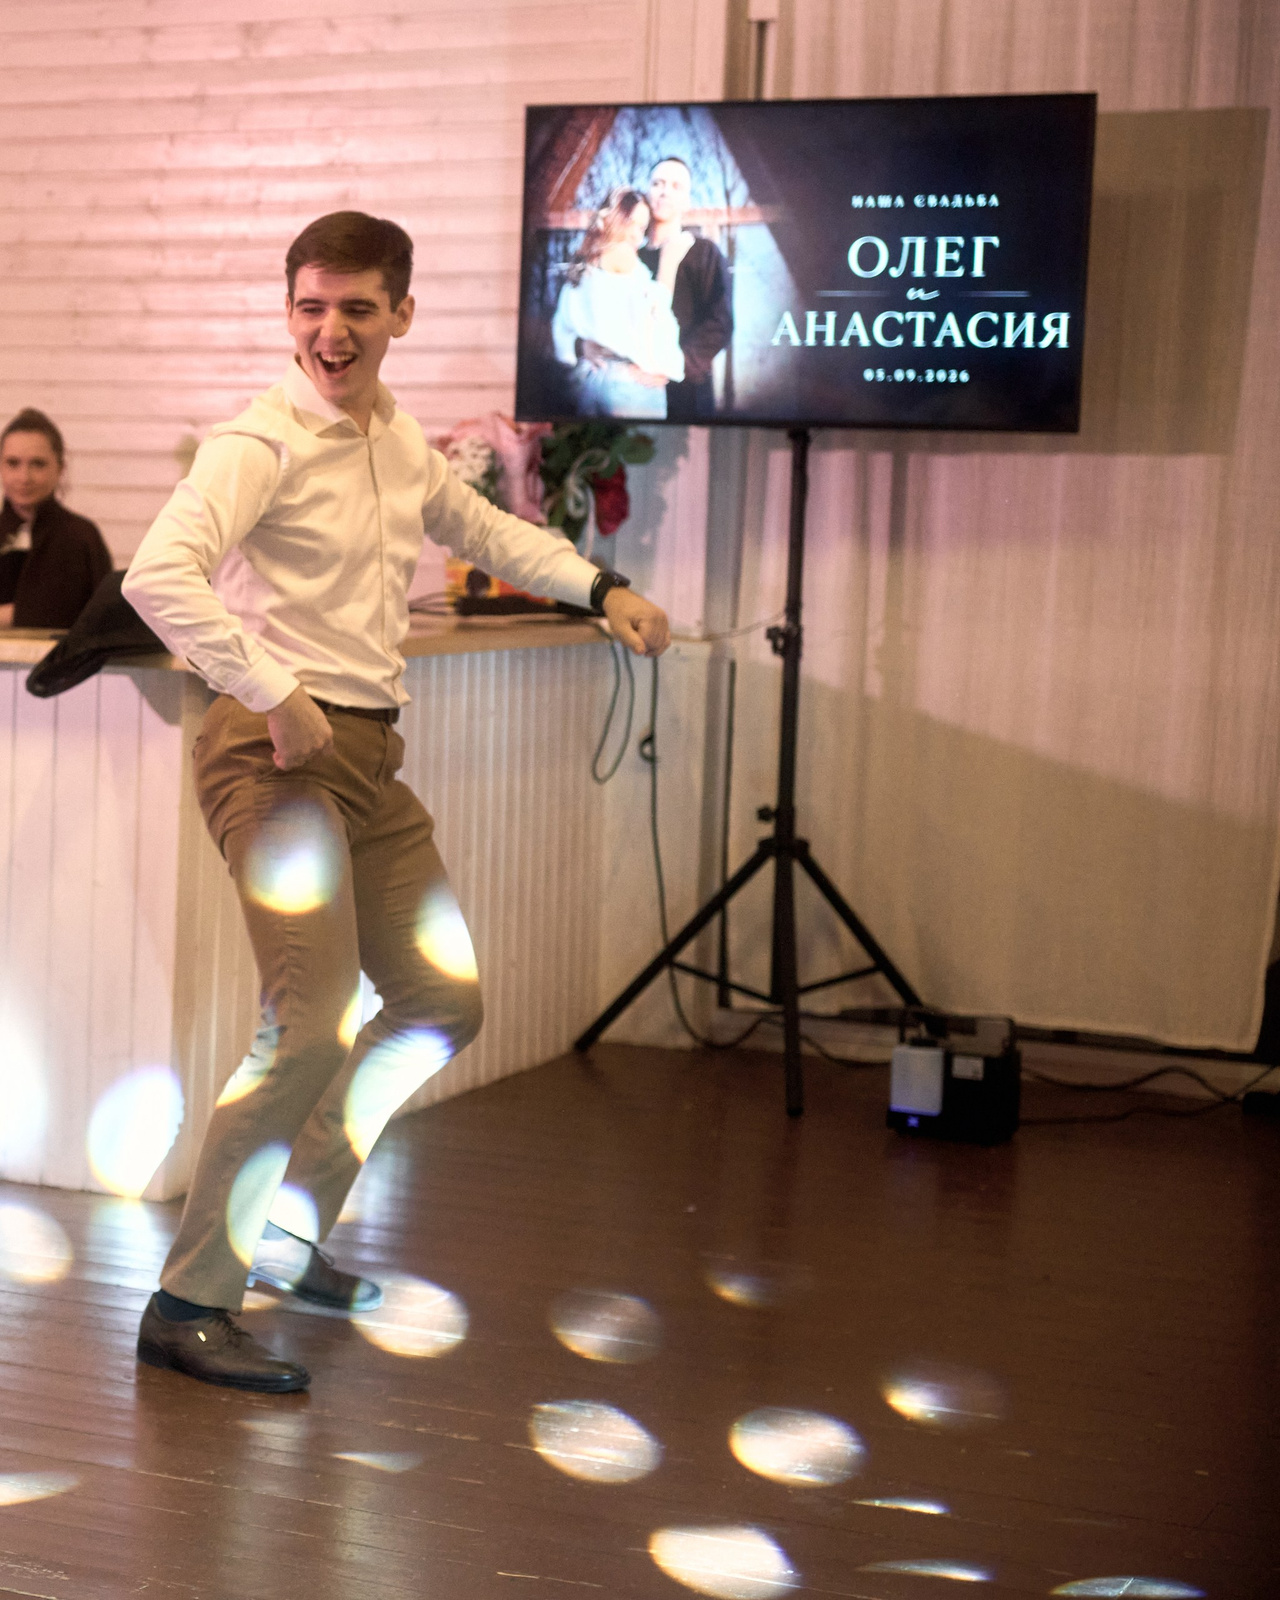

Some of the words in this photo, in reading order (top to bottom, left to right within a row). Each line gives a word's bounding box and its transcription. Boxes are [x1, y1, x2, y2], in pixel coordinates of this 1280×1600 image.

[851, 194, 905, 208] НАША
[913, 193, 1000, 208] СВАДЬБА
[847, 235, 1000, 278] ОЛЕГ
[771, 311, 1070, 349] АНАСТАСИЯ
[863, 368, 970, 383] 05.09.2026
